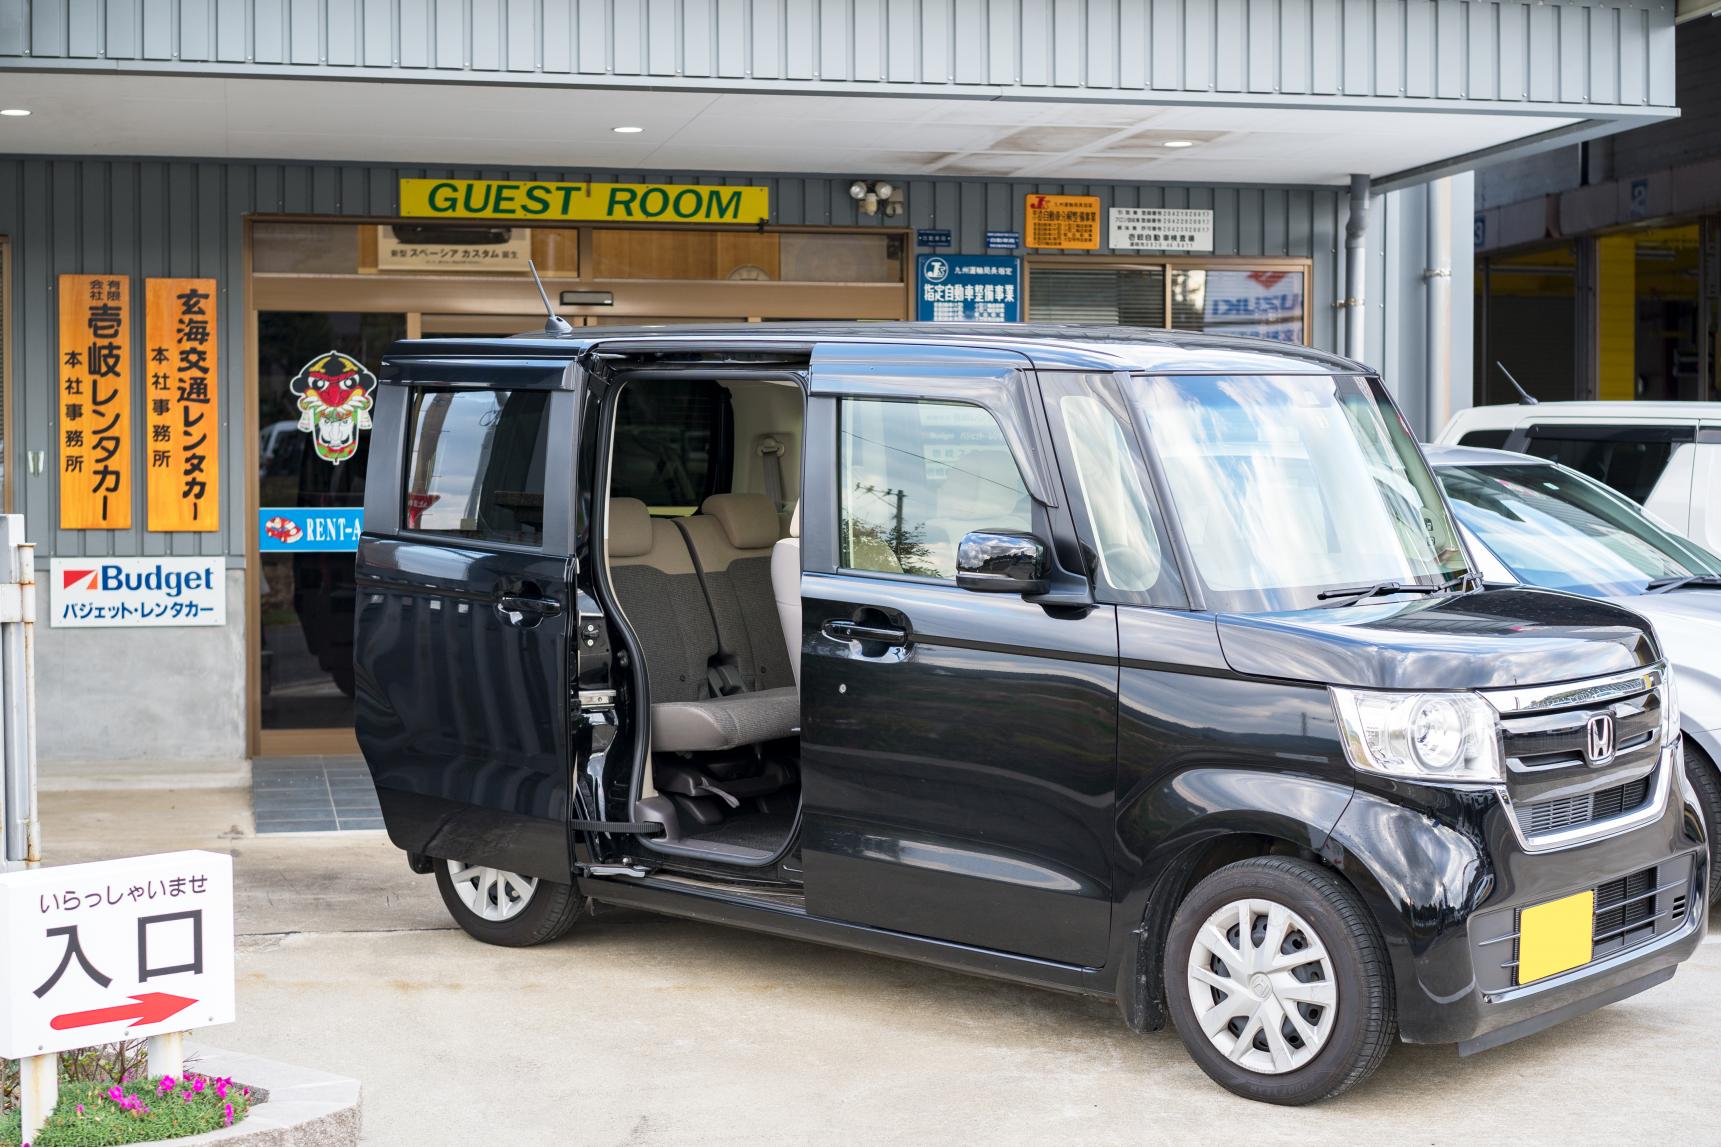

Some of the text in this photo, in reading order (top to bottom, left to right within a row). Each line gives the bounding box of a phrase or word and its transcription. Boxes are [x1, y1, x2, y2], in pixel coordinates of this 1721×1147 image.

[427, 182, 743, 219] GUEST ROOM
[409, 249, 459, 258] スペーシア
[461, 249, 499, 259] カスタム
[924, 283, 1015, 302] 指定自動車整備事業
[64, 350, 84, 473] 本社事務所
[151, 346, 171, 468] 本社事務所
[176, 288, 211, 521] 玄海交通レンタカー
[102, 564, 214, 597] Budget
[63, 601, 214, 619] バジェット・レンタカー
[40, 874, 208, 913] いらっしゃいませ
[32, 909, 203, 999] 入口
